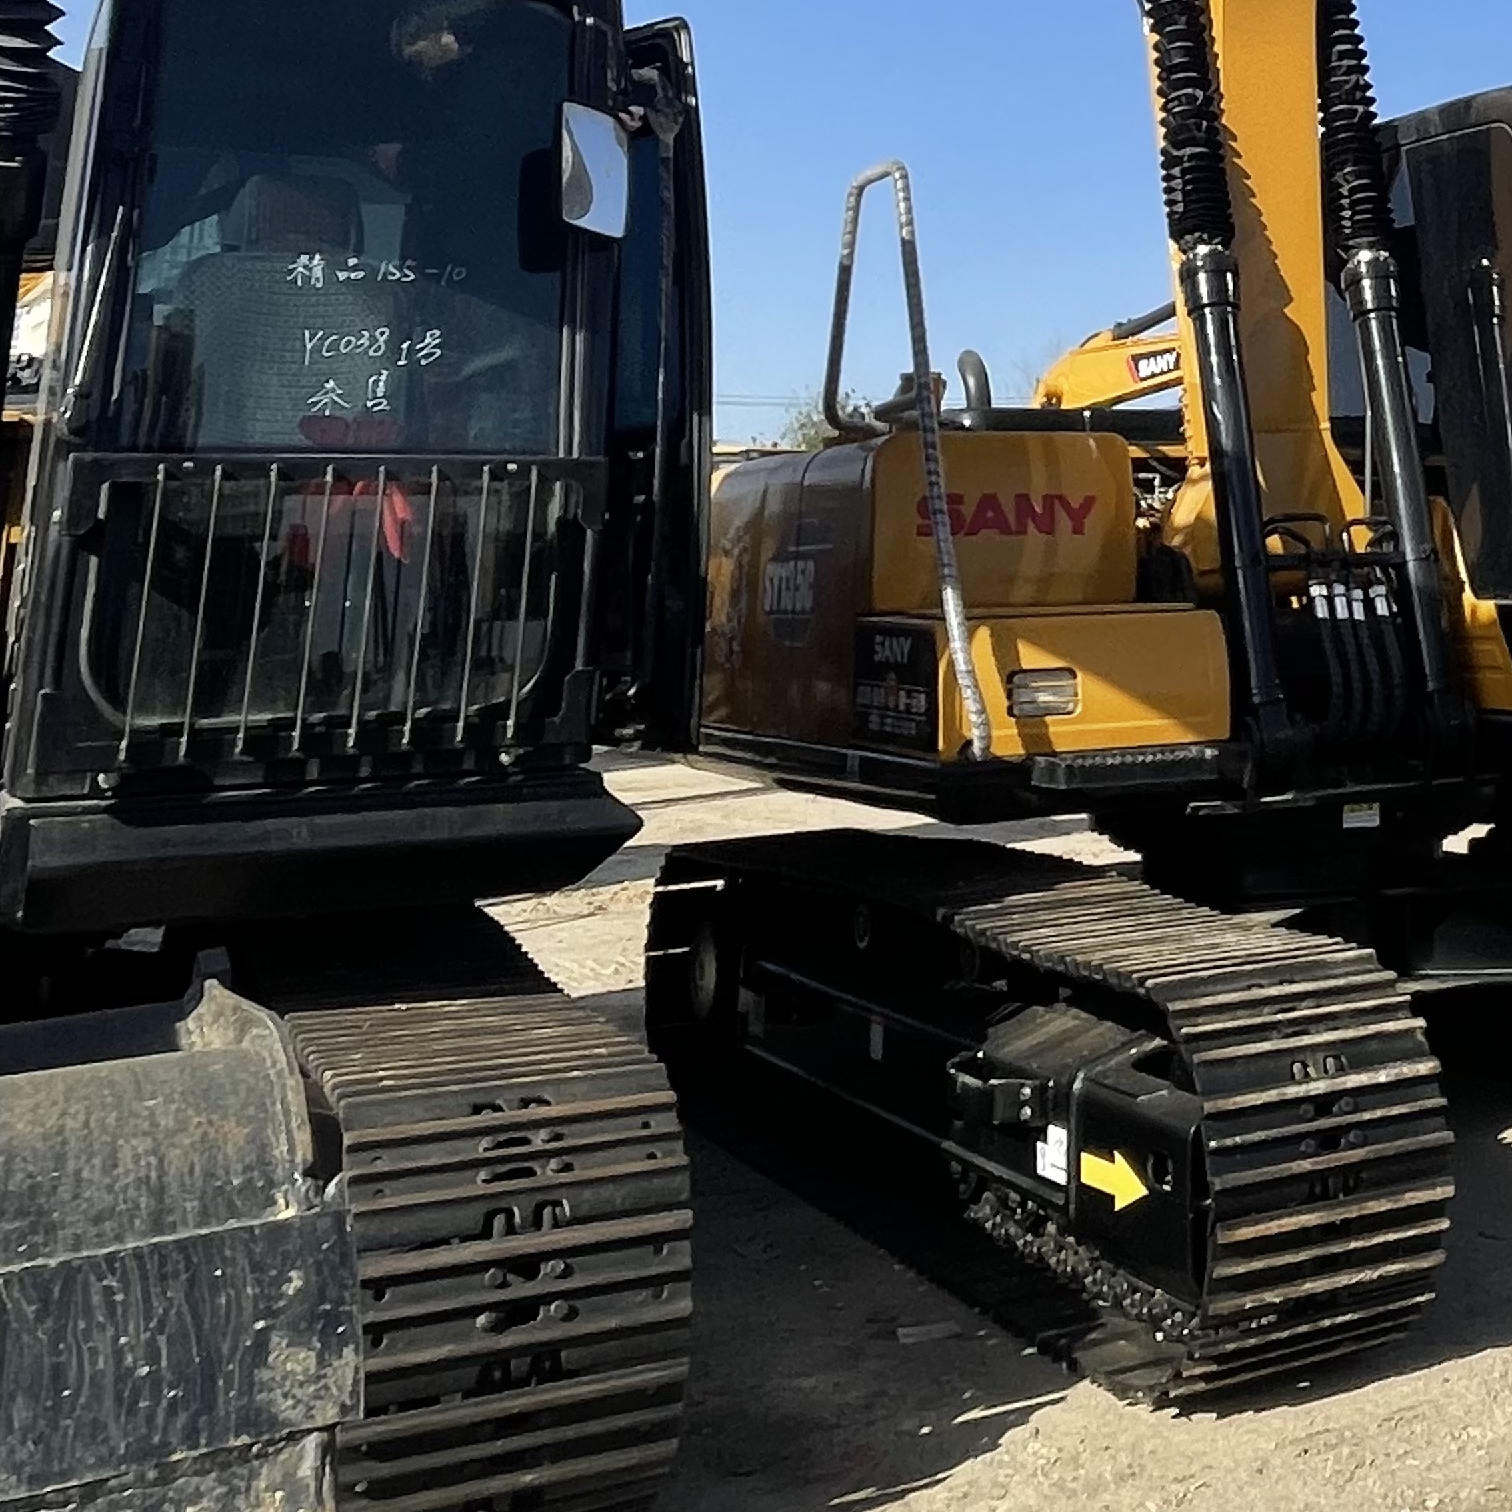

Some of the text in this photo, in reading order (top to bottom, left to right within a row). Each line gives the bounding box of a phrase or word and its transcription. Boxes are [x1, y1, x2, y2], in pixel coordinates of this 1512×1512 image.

[1138, 350, 1178, 378] SANY
[916, 493, 1096, 538] SANY
[873, 634, 912, 664] SANY
